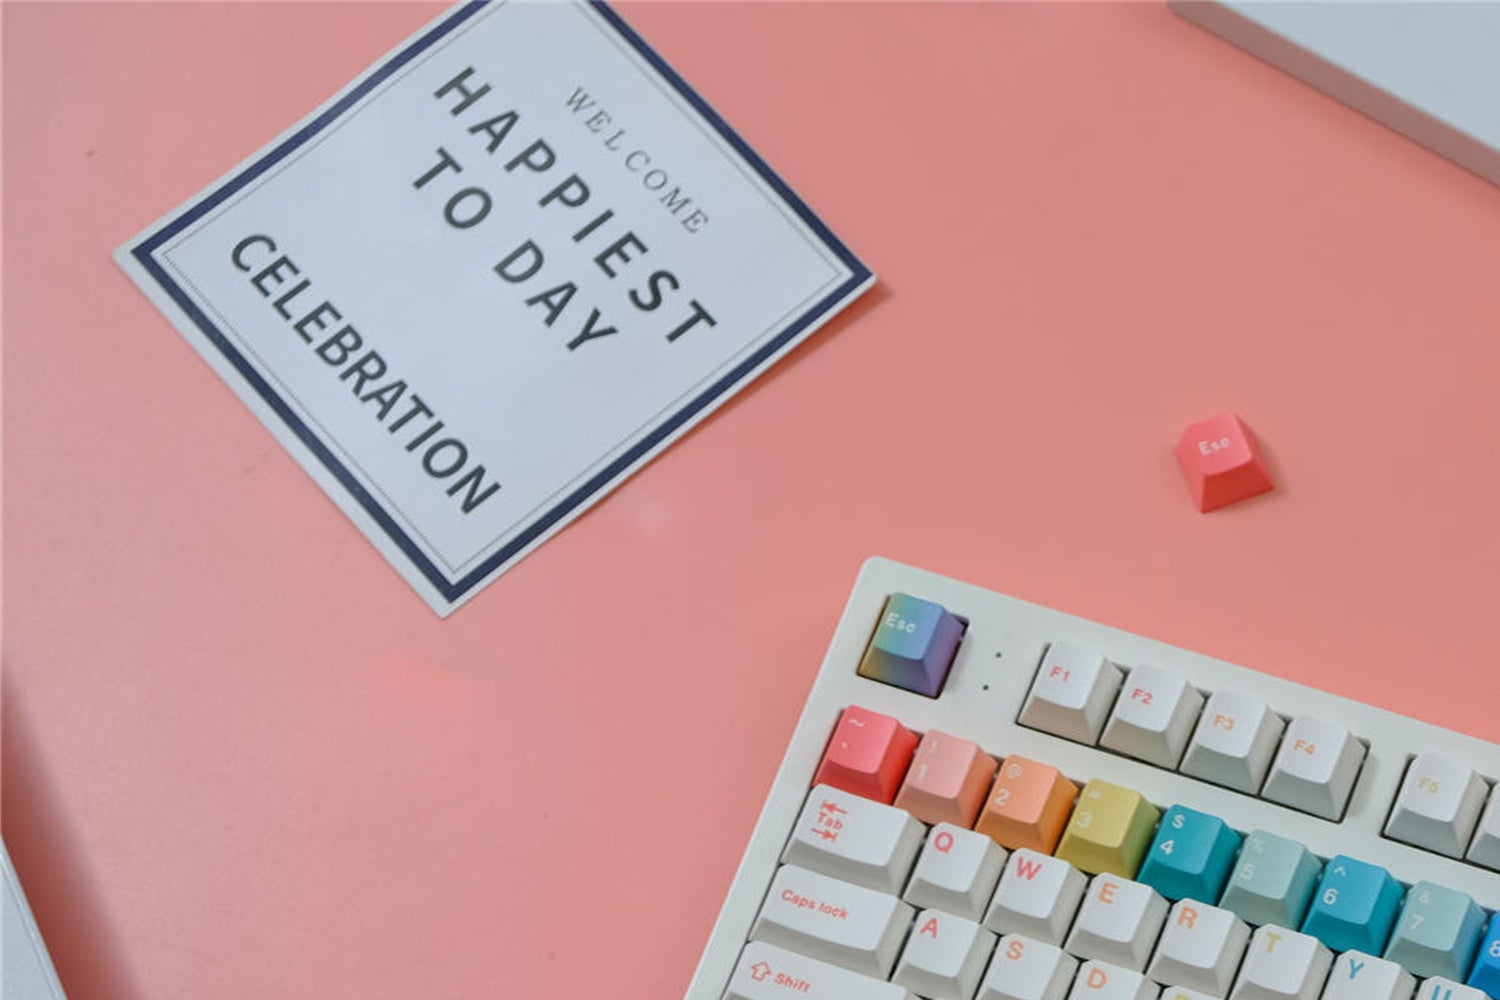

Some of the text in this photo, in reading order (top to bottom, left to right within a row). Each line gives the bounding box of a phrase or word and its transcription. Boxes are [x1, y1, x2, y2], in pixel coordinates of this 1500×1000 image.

[565, 86, 708, 236] WELCOME
[433, 66, 718, 344] HAPPIEST
[411, 148, 619, 353] TO DAY
[229, 234, 500, 515] CELEBRATION
[1197, 437, 1230, 456] Esc
[885, 611, 916, 633] Esc
[1050, 665, 1070, 682] F1
[1131, 687, 1153, 705] F2
[1213, 714, 1235, 730] F3
[1293, 739, 1315, 755] F4
[994, 788, 1010, 806] 2
[816, 811, 844, 831] Tab
[1076, 811, 1094, 829] 3
[934, 831, 955, 854] Q
[1159, 839, 1176, 855] 4
[1015, 856, 1043, 881] W
[781, 888, 816, 913] Caps
[1097, 882, 1119, 905] E
[1323, 887, 1339, 905] 6
[919, 918, 939, 938] A
[1177, 906, 1198, 929] R
[1409, 914, 1425, 931] 7
[1005, 940, 1025, 961] S
[1265, 932, 1283, 953] T
[1086, 968, 1108, 990] D
[1348, 958, 1366, 980] Y
[774, 971, 811, 994] Shift
